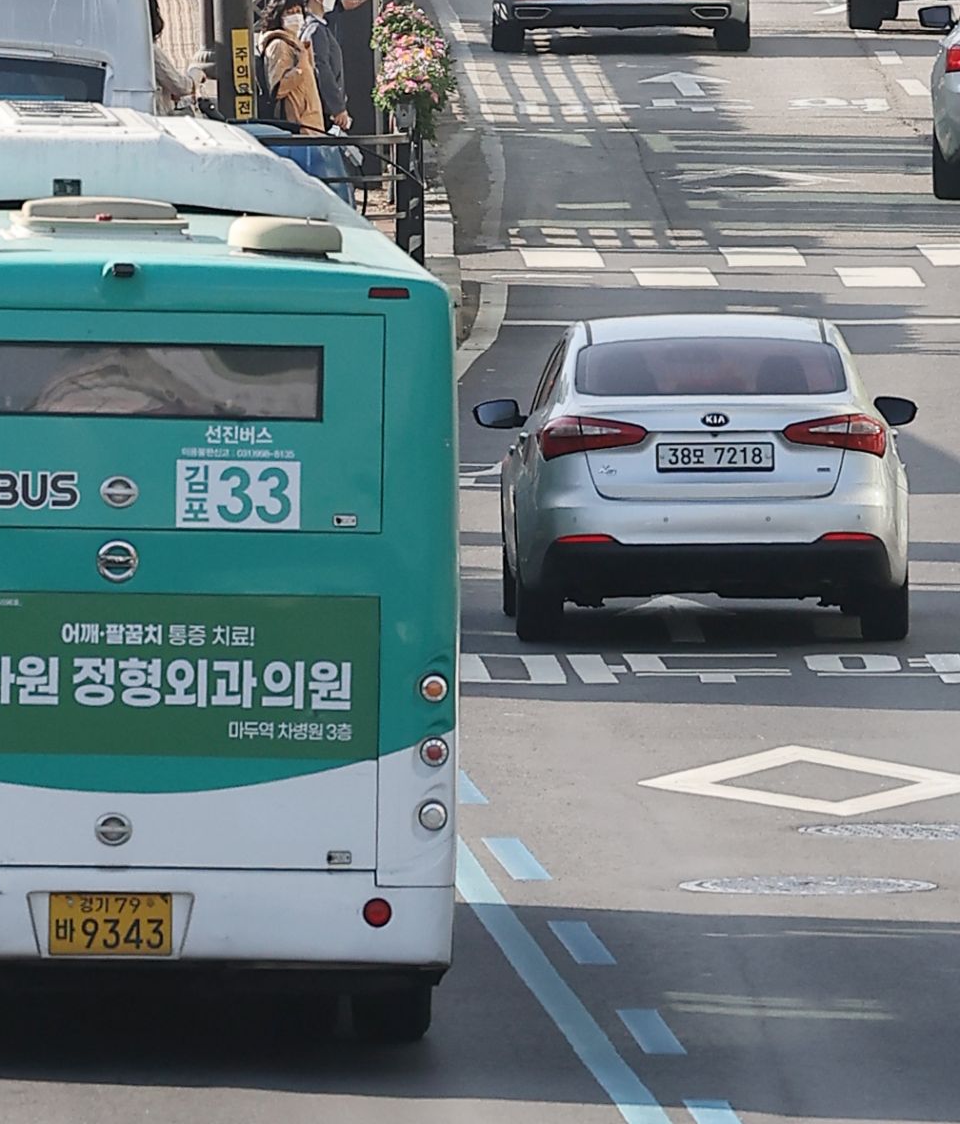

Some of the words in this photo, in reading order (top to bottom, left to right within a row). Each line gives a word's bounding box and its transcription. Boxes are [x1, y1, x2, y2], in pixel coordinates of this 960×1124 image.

[705, 414, 726, 425] KIA
[204, 424, 273, 445] 선진버스
[713, 446, 763, 465] 7218
[217, 465, 292, 524] 33
[168, 625, 206, 647] 통증
[212, 625, 255, 647] 치료!
[228, 721, 274, 740] 마두역
[277, 723, 323, 741] 차병원
[326, 723, 353, 741] 3층
[80, 896, 110, 914] 경기
[114, 896, 141, 914] 79
[55, 918, 76, 944] 바
[81, 918, 165, 950] 9343
